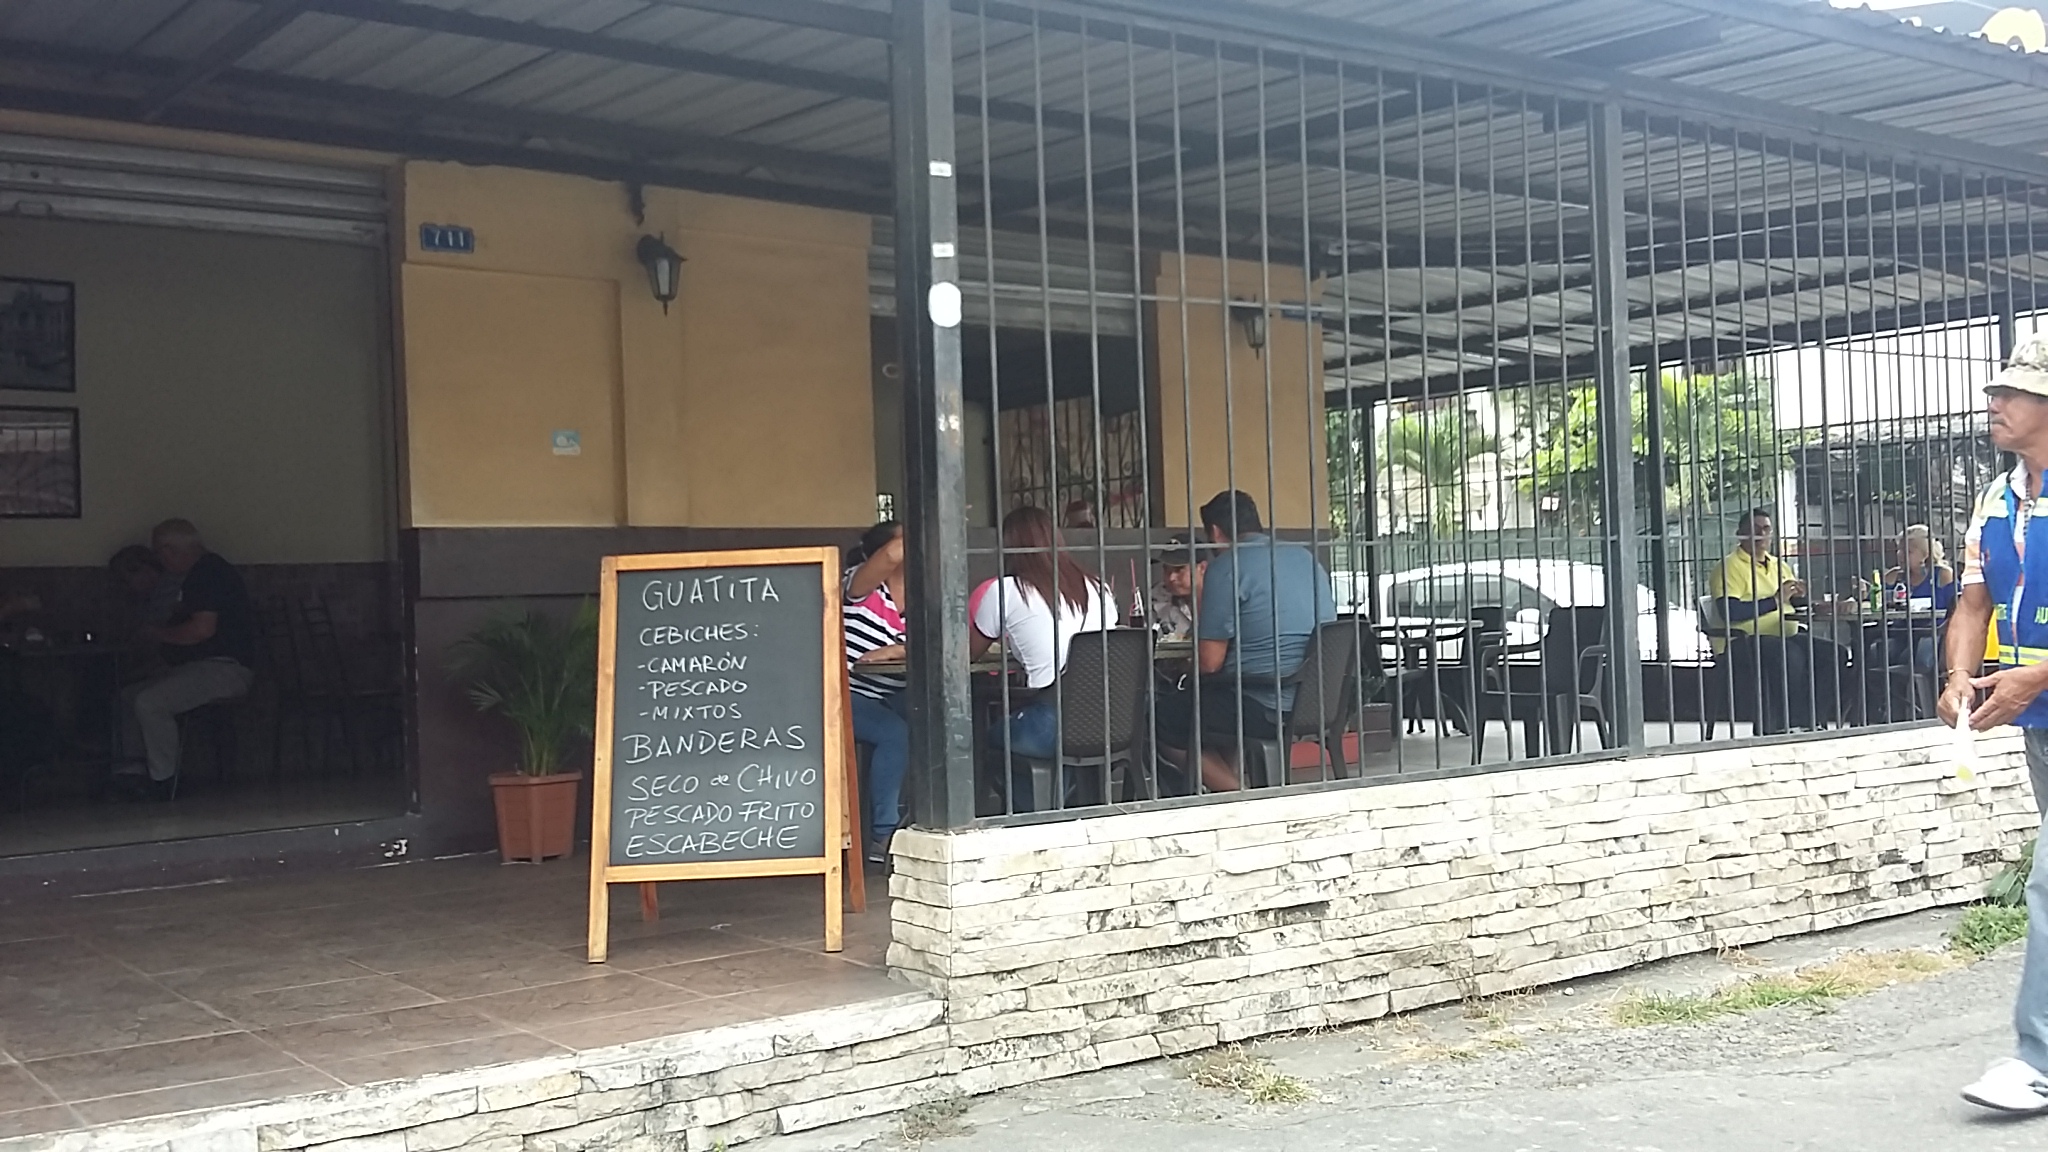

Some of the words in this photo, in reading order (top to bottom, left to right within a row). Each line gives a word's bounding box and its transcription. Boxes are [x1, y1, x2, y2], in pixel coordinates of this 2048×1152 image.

[639, 622, 759, 647] CEBICHES:
[638, 678, 748, 700] -PESCADO
[622, 725, 806, 764] BANDERAS
[627, 775, 699, 801] SECO
[710, 774, 731, 787] de
[737, 763, 816, 793] CHIVO
[624, 802, 732, 829] PESCADO
[738, 801, 815, 823] FRITO
[625, 825, 800, 858] ESCABECHE
